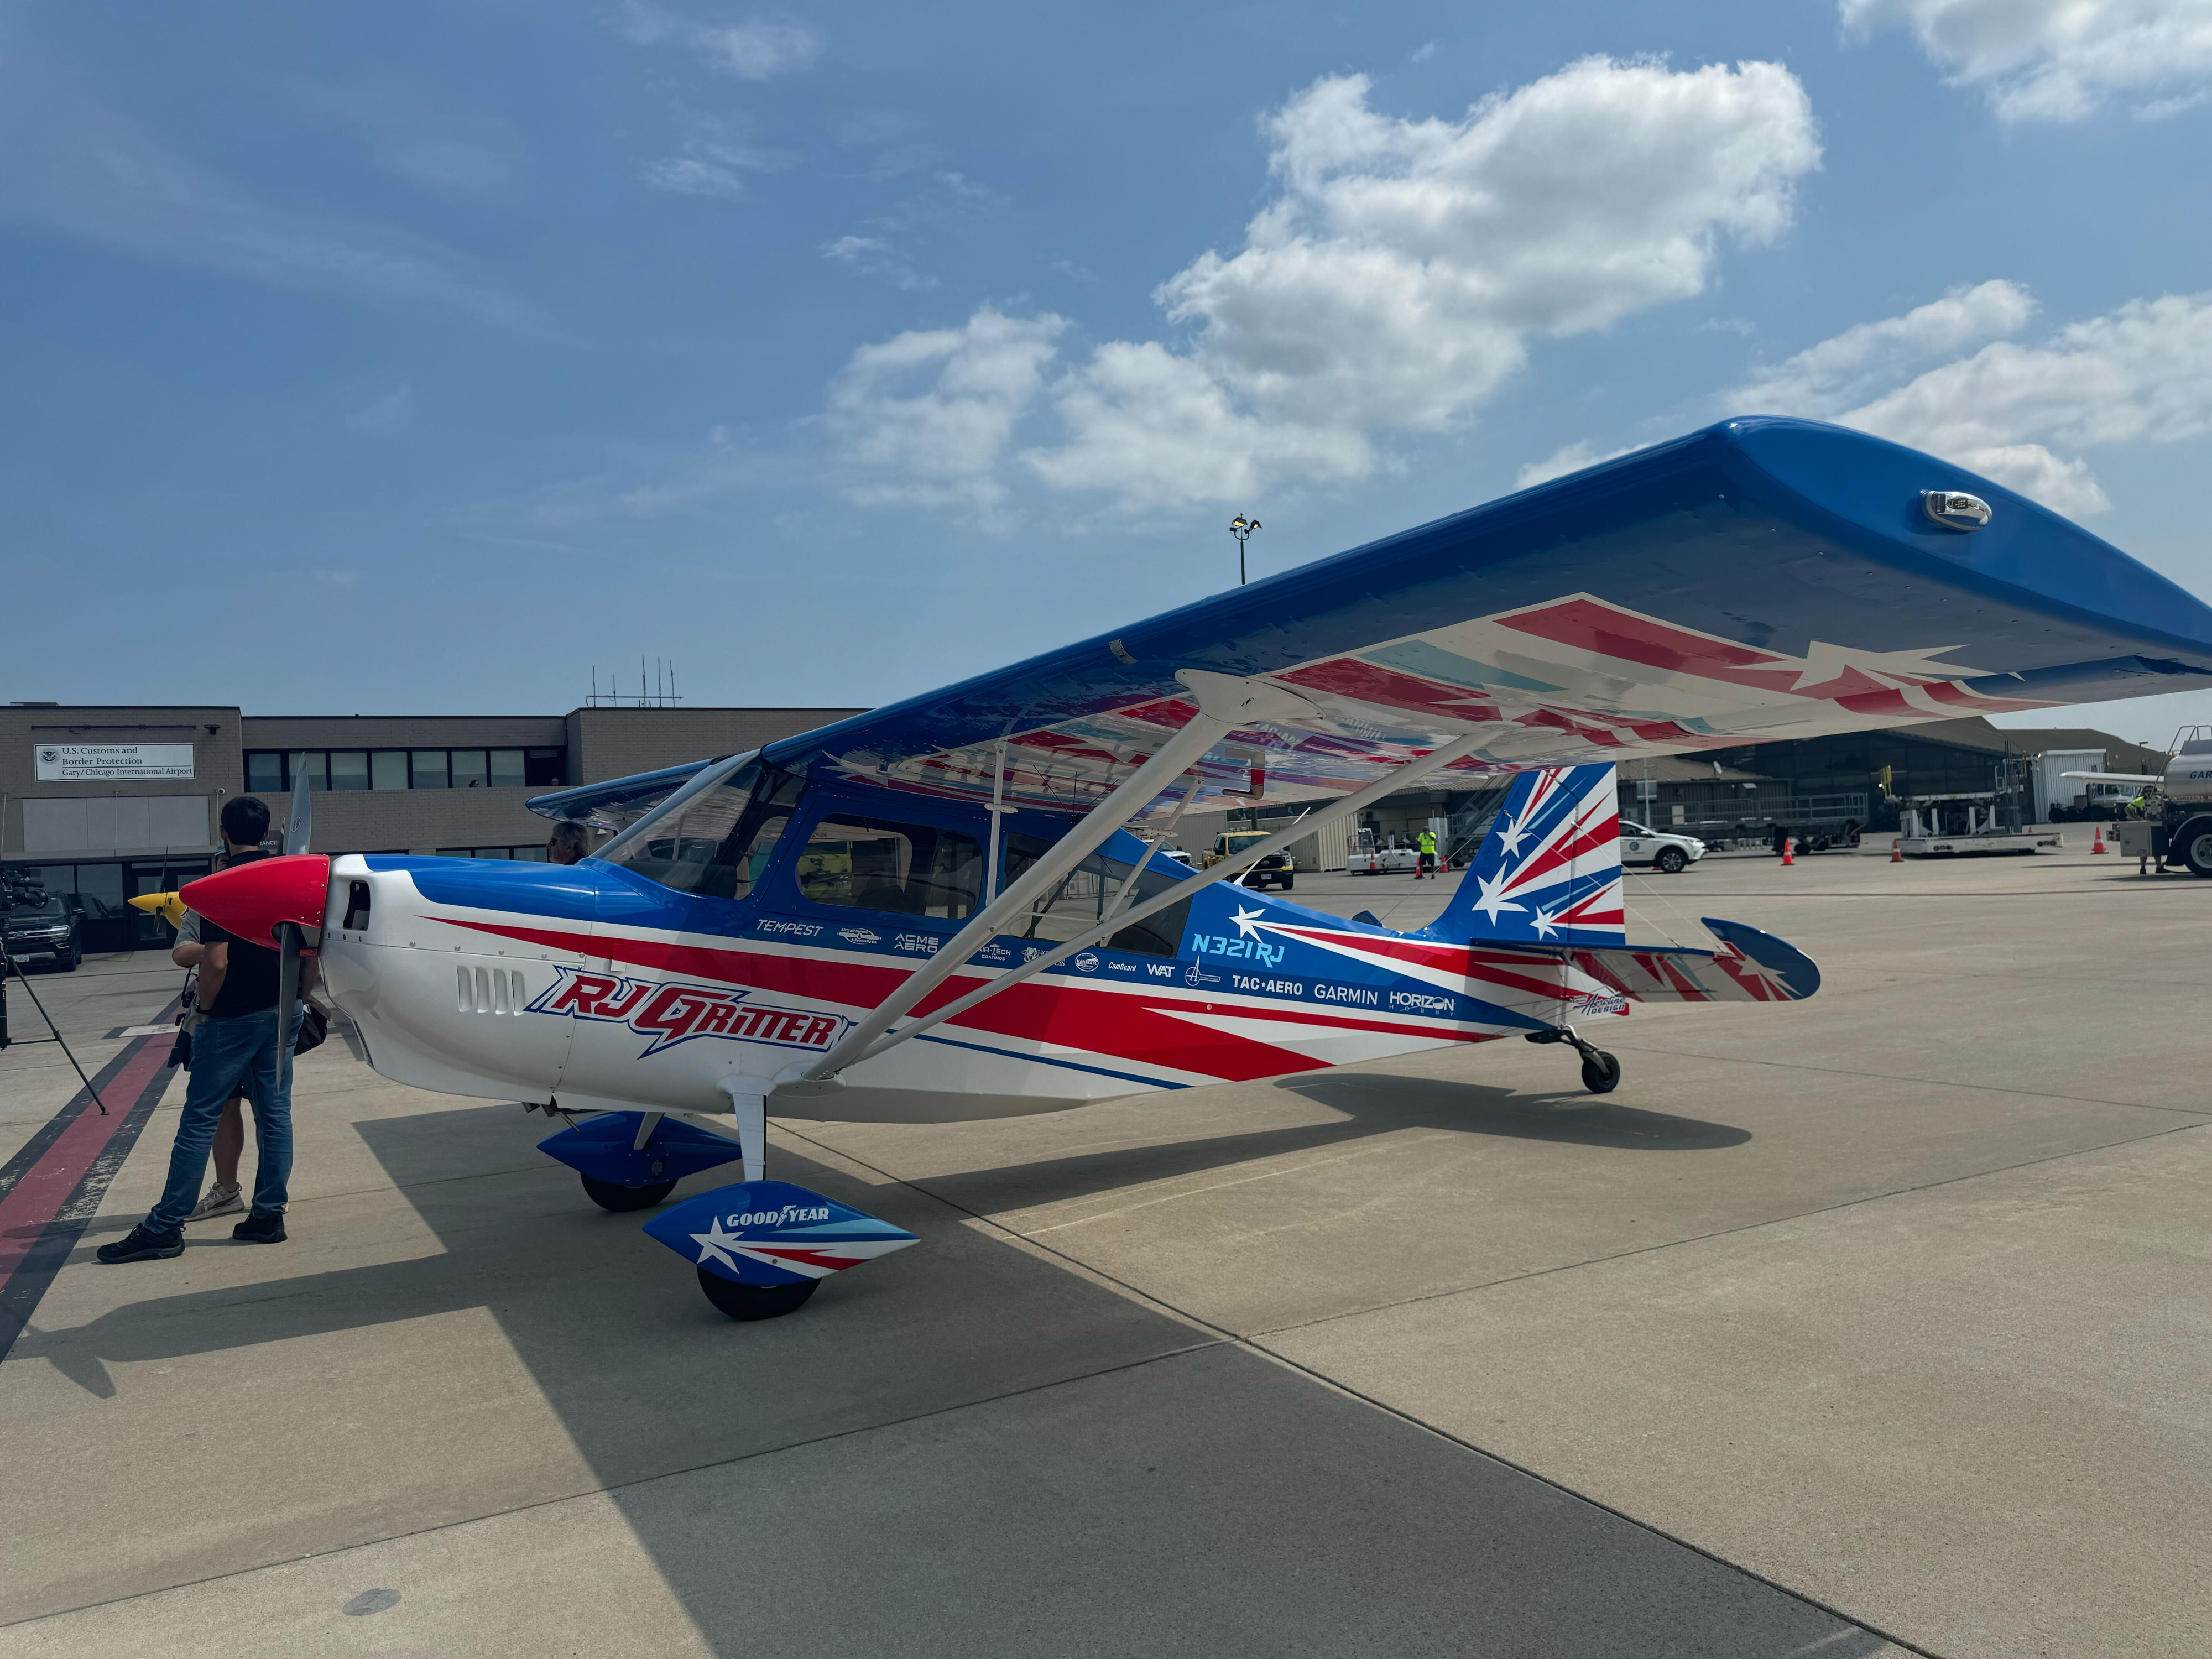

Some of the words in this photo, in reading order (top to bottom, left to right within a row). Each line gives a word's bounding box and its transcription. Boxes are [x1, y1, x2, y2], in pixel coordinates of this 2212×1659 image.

[62, 768, 114, 777] Gary/Chicago
[757, 919, 824, 937] TEMPEST
[894, 941, 938, 953] AERO
[895, 933, 938, 946] ACME
[1192, 933, 1285, 968] N321RJ
[1108, 962, 1137, 972] CamGuard
[1146, 963, 1175, 978] WAT
[550, 974, 652, 1018] RJ
[1314, 984, 1378, 1005] GARMIN
[1390, 991, 1455, 1011] HORIZON
